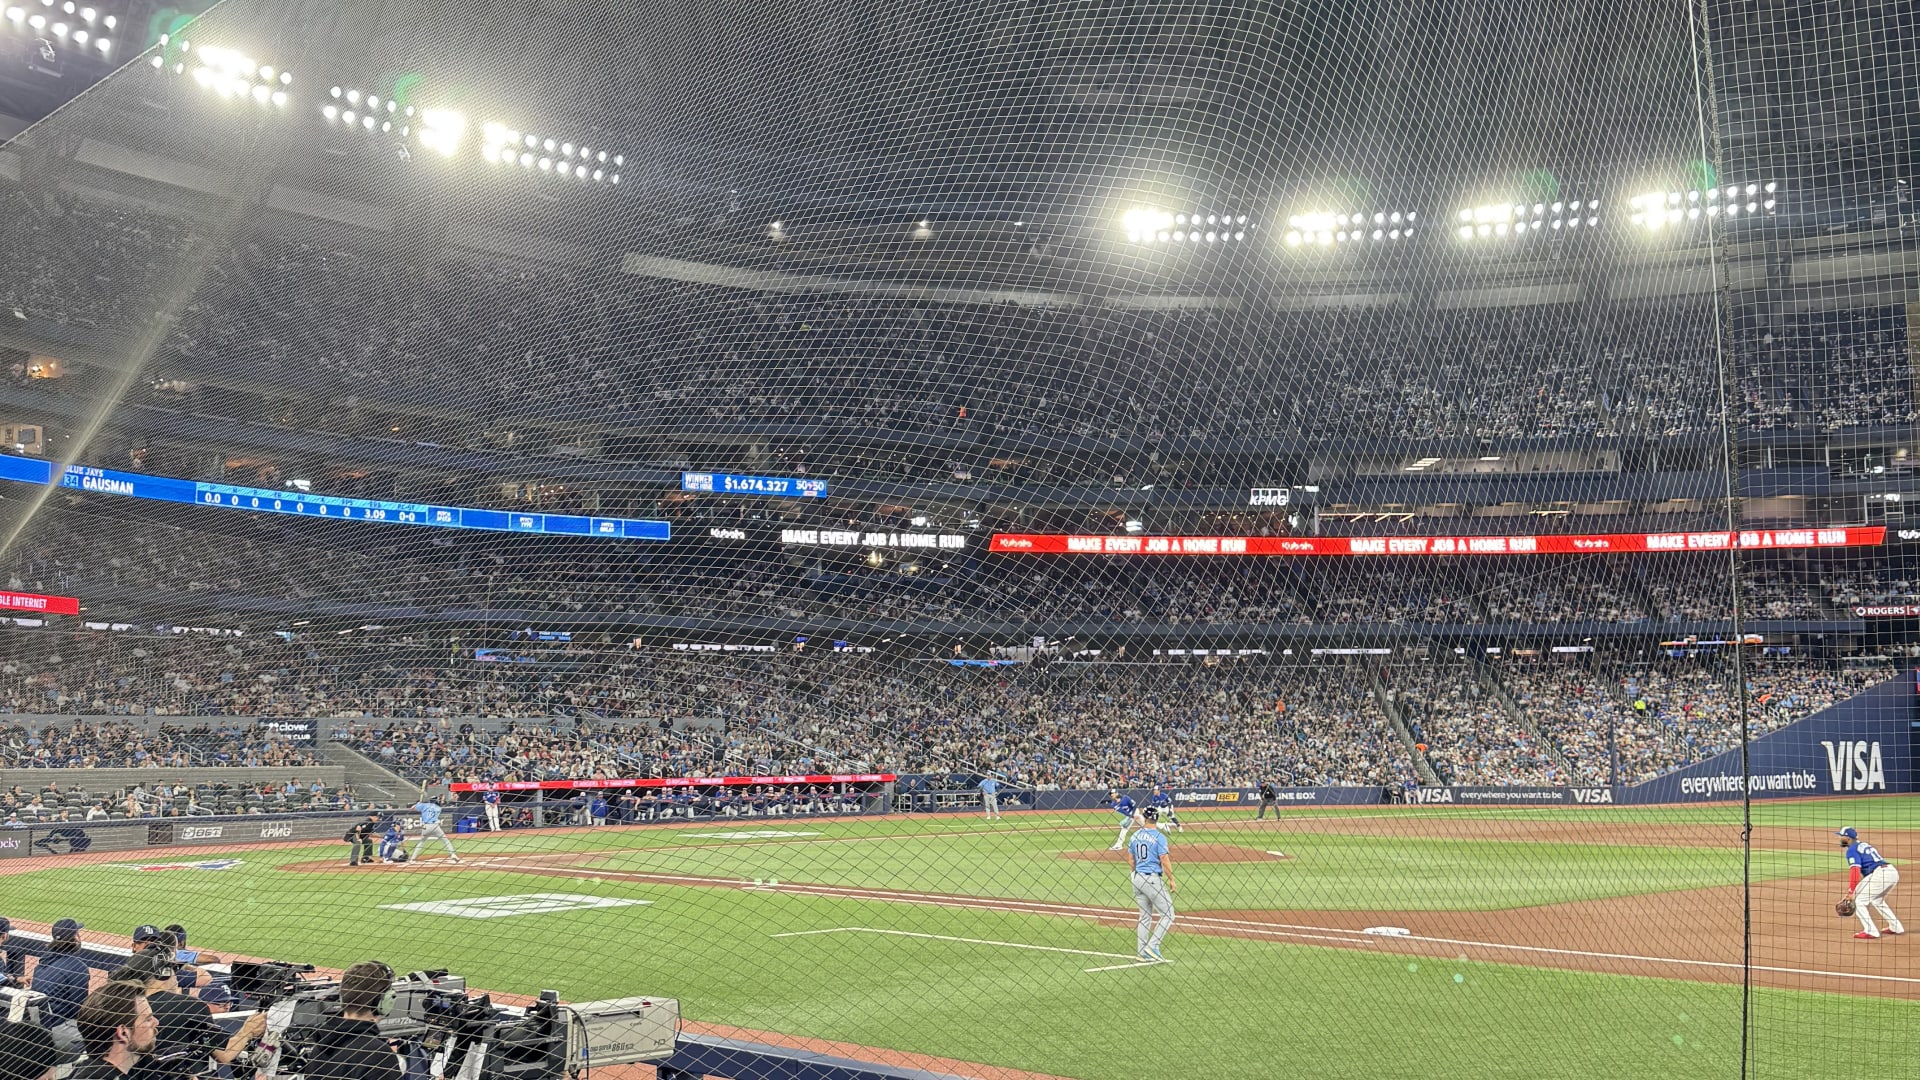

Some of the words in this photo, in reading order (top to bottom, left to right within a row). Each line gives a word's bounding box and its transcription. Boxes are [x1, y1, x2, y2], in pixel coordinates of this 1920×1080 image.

[84, 468, 104, 478] JAYS
[685, 472, 713, 483] WINNER
[65, 475, 78, 487] 34
[82, 476, 134, 495] GAUSMAN
[1249, 493, 1288, 506] KPMG
[204, 492, 221, 504] 0.0
[231, 495, 239, 506] 0
[251, 497, 259, 508] 0
[274, 499, 281, 510] 0
[296, 502, 304, 512] 0
[319, 505, 327, 515] 0
[343, 507, 351, 517] 0
[364, 508, 386, 519] 3.09
[399, 511, 415, 522] 0-0
[710, 527, 745, 540] Kubota
[781, 529, 818, 544] MAKE
[820, 530, 859, 545] EVERY
[862, 532, 887, 546] JOB
[888, 533, 899, 547] A
[901, 533, 936, 548] HOME
[939, 534, 965, 549] RUN
[1897, 529, 1920, 540] Kub
[1000, 538, 1033, 548] Kubota
[1067, 537, 1102, 551] MAKE
[1105, 537, 1141, 551] EVERY
[1145, 538, 1169, 551] JOB
[1171, 538, 1181, 551] A
[1183, 538, 1218, 551] HOME
[1221, 539, 1246, 552] RUN
[1281, 541, 1314, 551] Kubota
[1350, 539, 1386, 551] MAKE
[1389, 539, 1428, 551] EVERY
[1431, 538, 1455, 551] JOB
[1457, 538, 1467, 551] A
[1469, 538, 1506, 551] HOME
[1509, 537, 1536, 551] RUN
[1646, 535, 1685, 549] MAKE
[1687, 534, 1731, 548] EVERY
[1762, 533, 1773, 546] A
[1775, 531, 1814, 545] HOME
[1817, 530, 1847, 544] RUN
[12, 596, 48, 609] INTERNET
[1867, 606, 1905, 615] ROGERS
[279, 721, 309, 732] clover
[1820, 740, 1886, 792] VISA
[1681, 771, 1744, 798] everywhere
[1747, 774, 1766, 795] you
[1766, 771, 1792, 790] want
[1792, 771, 1803, 790] to
[1803, 769, 1817, 789] be
[1175, 791, 1217, 801] theScore
[1219, 792, 1237, 800] BET
[1295, 792, 1316, 800] BOX
[1416, 788, 1453, 802] VISA
[1460, 790, 1506, 800] everywhere
[1506, 792, 1521, 801] you
[1522, 791, 1543, 799] want
[1543, 791, 1551, 799] to
[1552, 791, 1563, 799] be
[1570, 788, 1613, 803] VISA
[259, 825, 292, 838] KPMG
[1136, 843, 1148, 860] 10
